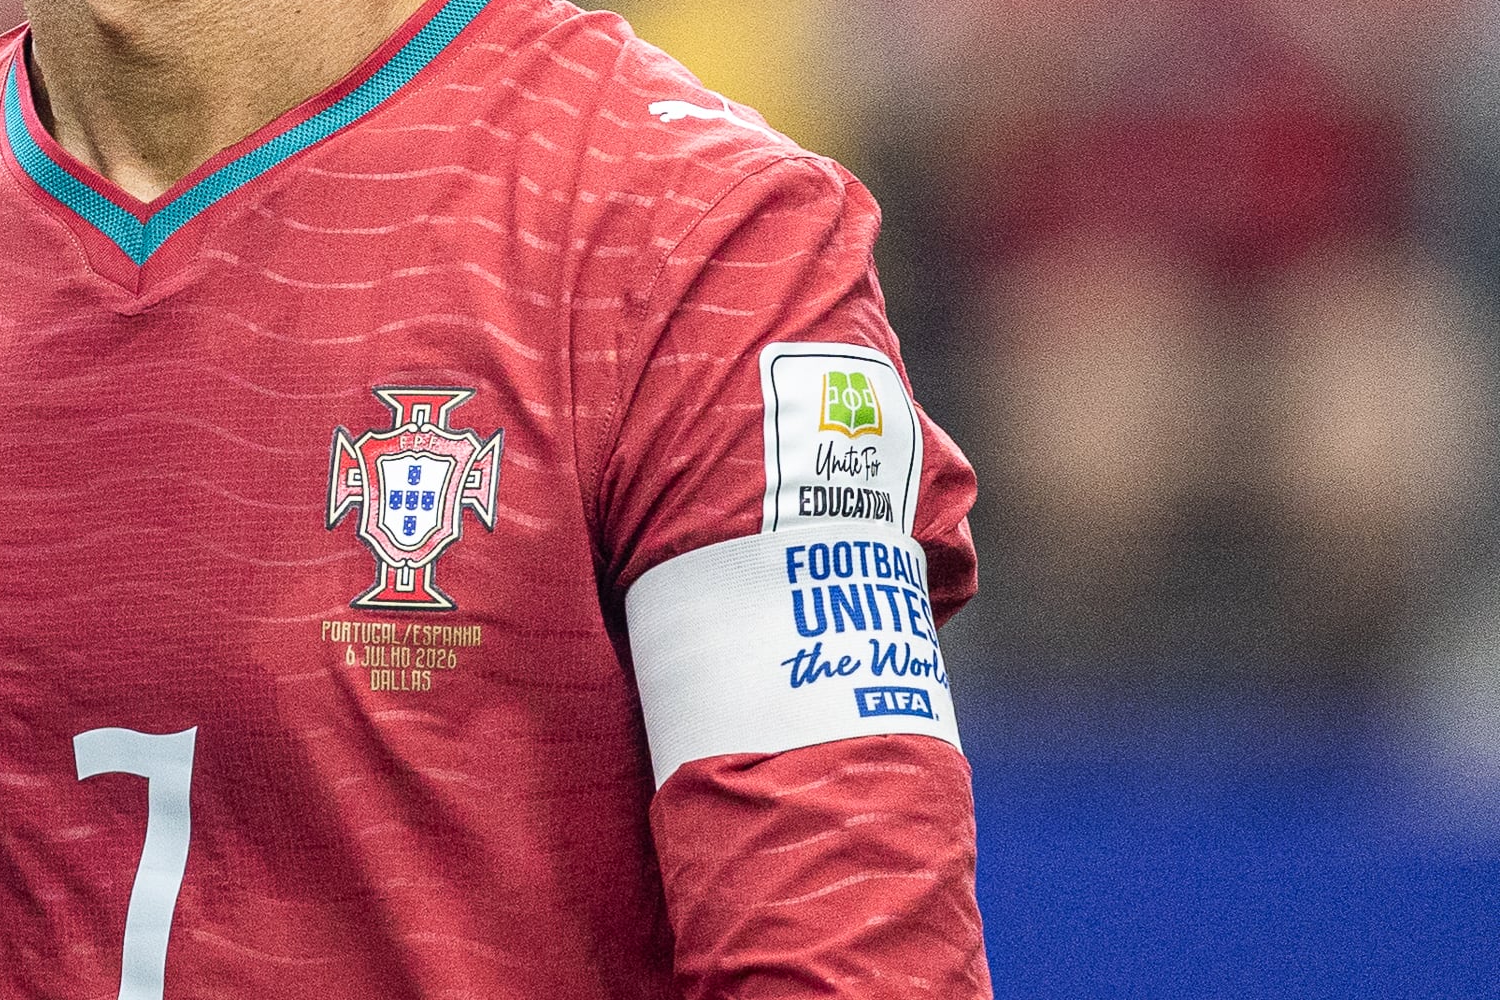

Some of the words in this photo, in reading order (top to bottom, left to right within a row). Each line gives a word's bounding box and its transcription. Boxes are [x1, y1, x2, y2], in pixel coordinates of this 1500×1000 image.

[816, 440, 862, 481] Unite
[861, 446, 881, 481] For
[799, 486, 893, 523] EDUCATION
[786, 541, 927, 596] FOOTBALL
[792, 584, 939, 649] UNITES
[345, 645, 356, 666] 6
[361, 645, 411, 668] JULHO
[415, 648, 457, 669] 2026
[781, 642, 861, 688] the
[370, 669, 432, 692] DALLAS
[863, 691, 929, 713] FIFA
[72, 725, 198, 1000] 7
